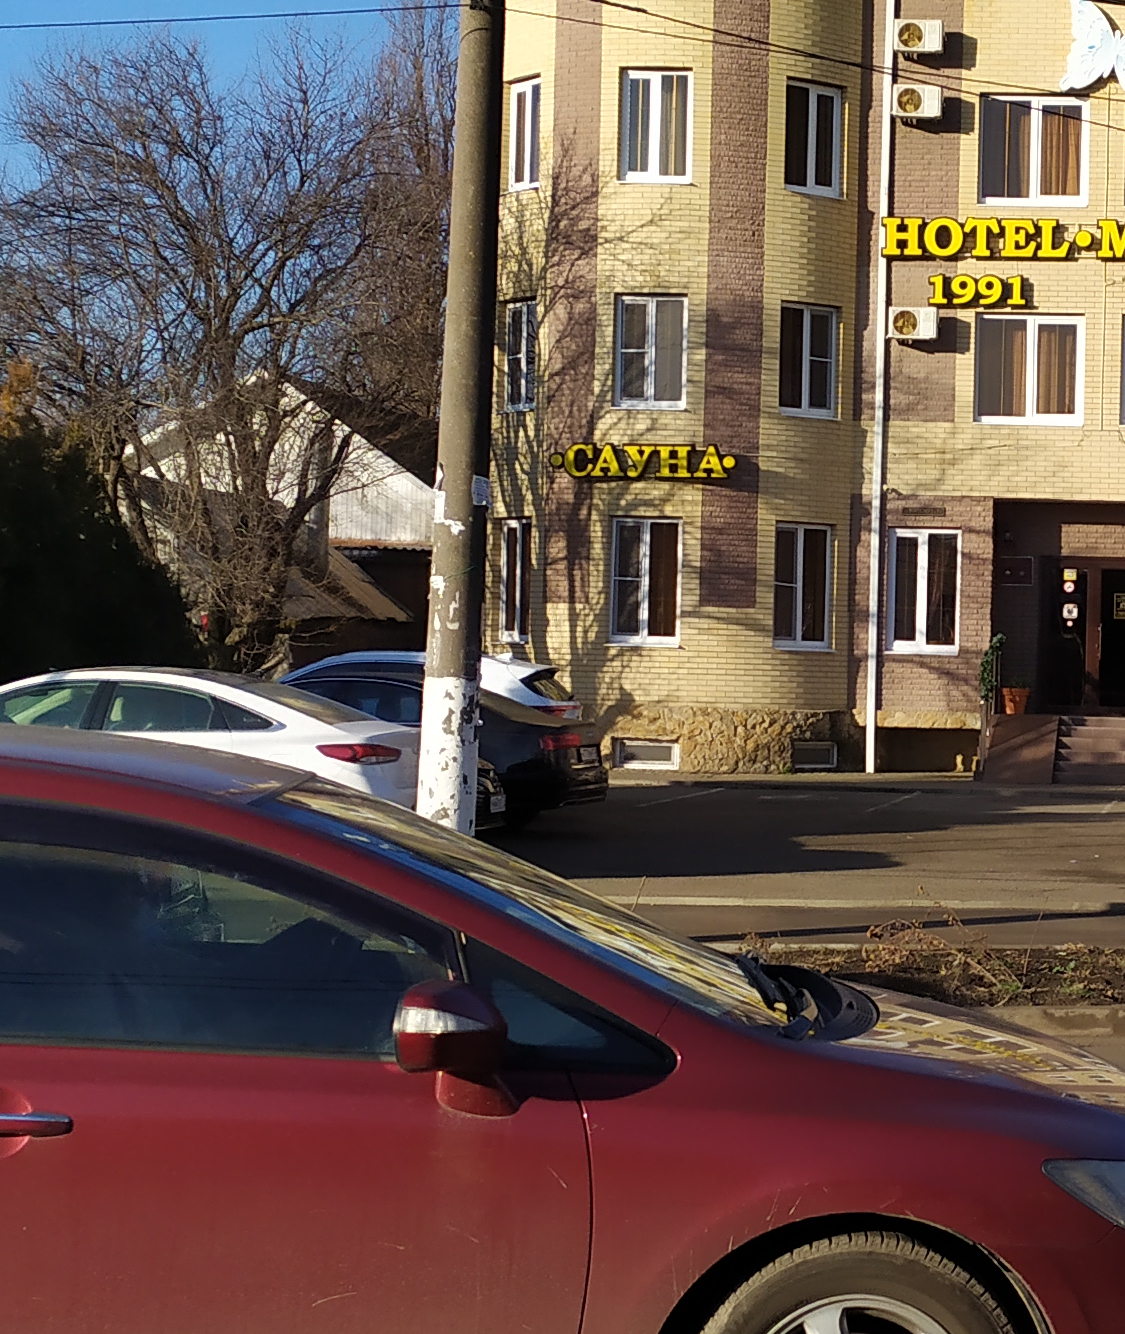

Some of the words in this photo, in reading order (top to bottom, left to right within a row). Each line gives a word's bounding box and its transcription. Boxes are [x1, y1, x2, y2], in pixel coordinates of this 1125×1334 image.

[881, 216, 1071, 258] HOTEL
[928, 273, 1027, 306] 1991
[563, 443, 728, 479] САУНА
